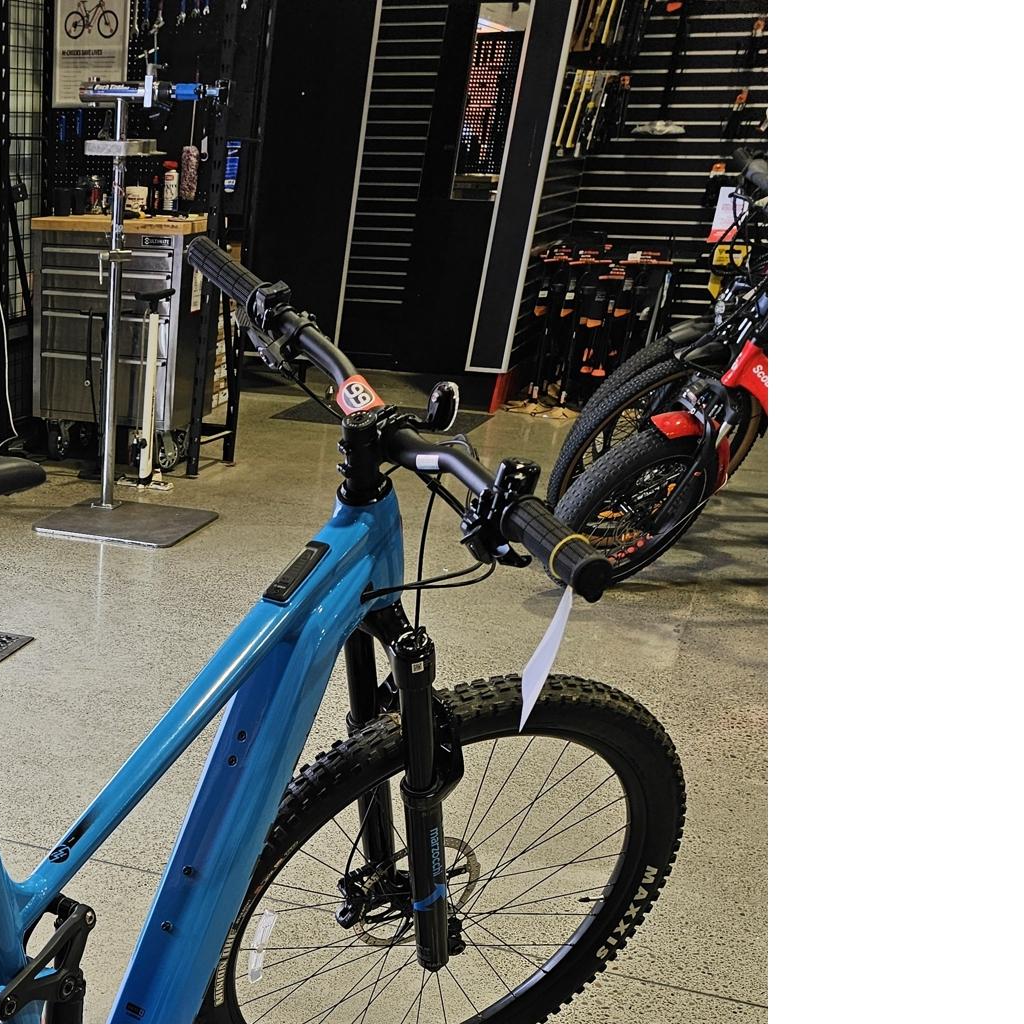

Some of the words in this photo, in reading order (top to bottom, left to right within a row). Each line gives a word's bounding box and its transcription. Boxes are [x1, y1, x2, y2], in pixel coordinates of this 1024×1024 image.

[344, 383, 372, 409] 99
[429, 827, 443, 878] marzocchi
[595, 865, 659, 960] MAXXIS
